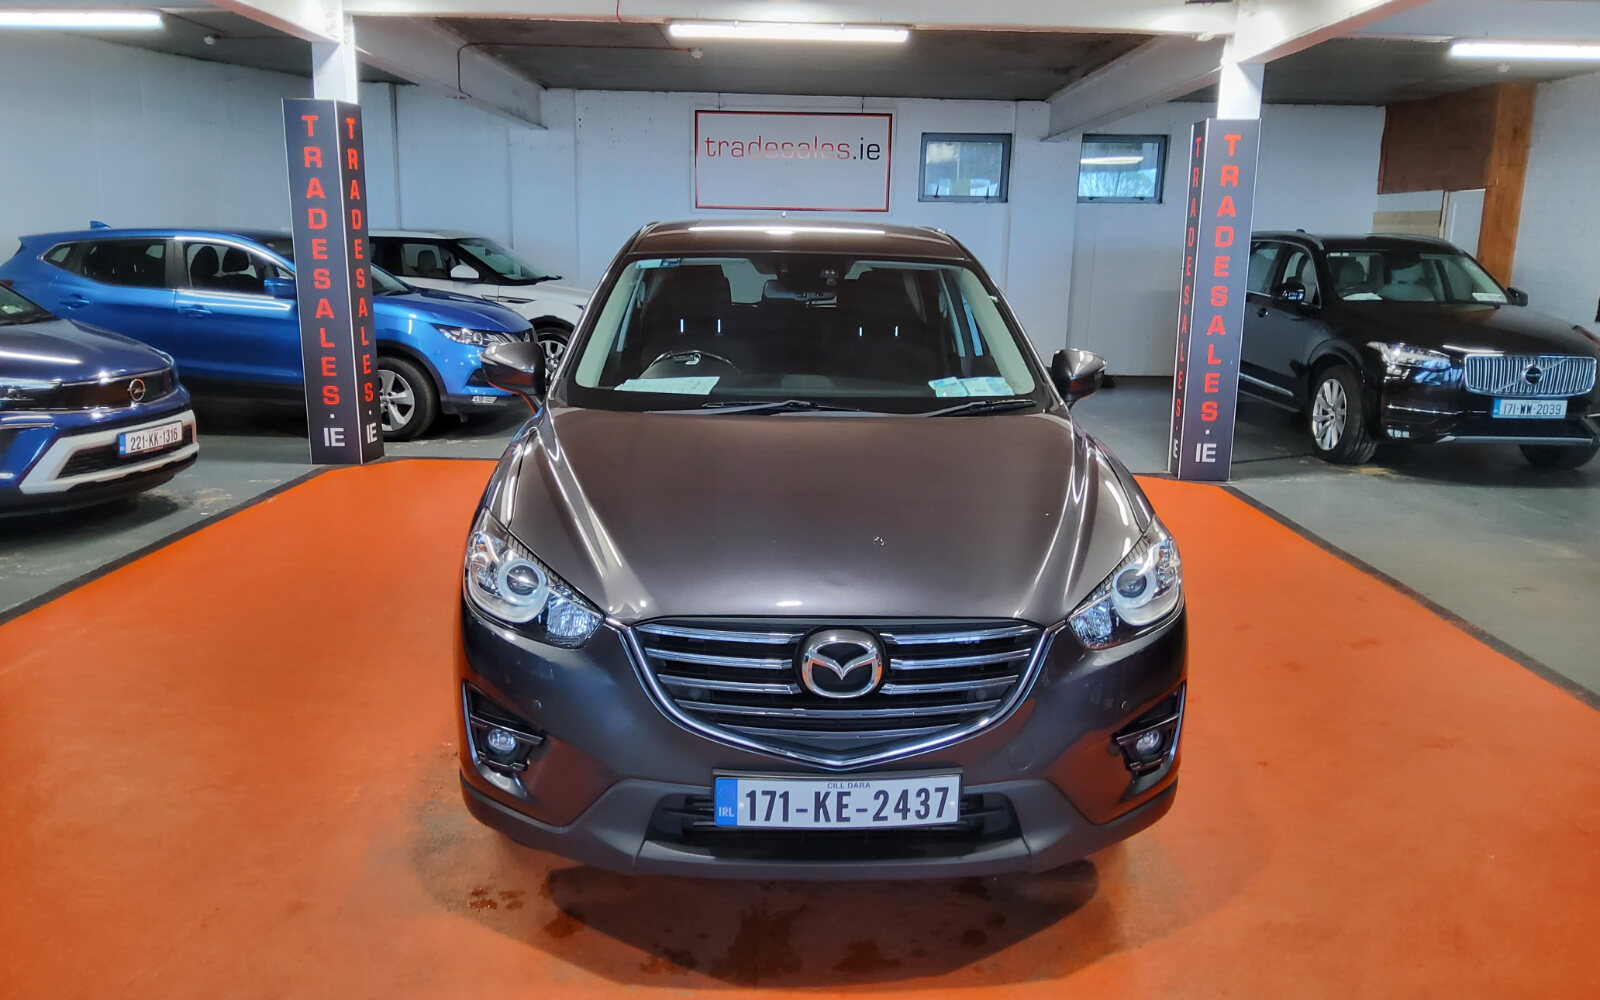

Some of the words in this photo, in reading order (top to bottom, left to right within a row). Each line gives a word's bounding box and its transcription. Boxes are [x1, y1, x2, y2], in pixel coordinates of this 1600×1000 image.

[704, 135, 881, 161] tradesales.ie
[1503, 403, 1562, 415] 171-WW-2039
[130, 427, 178, 451] 221-KK-1316
[847, 781, 871, 789] DARA
[718, 807, 735, 818] IRL
[745, 786, 950, 823] 171-KE-2437
